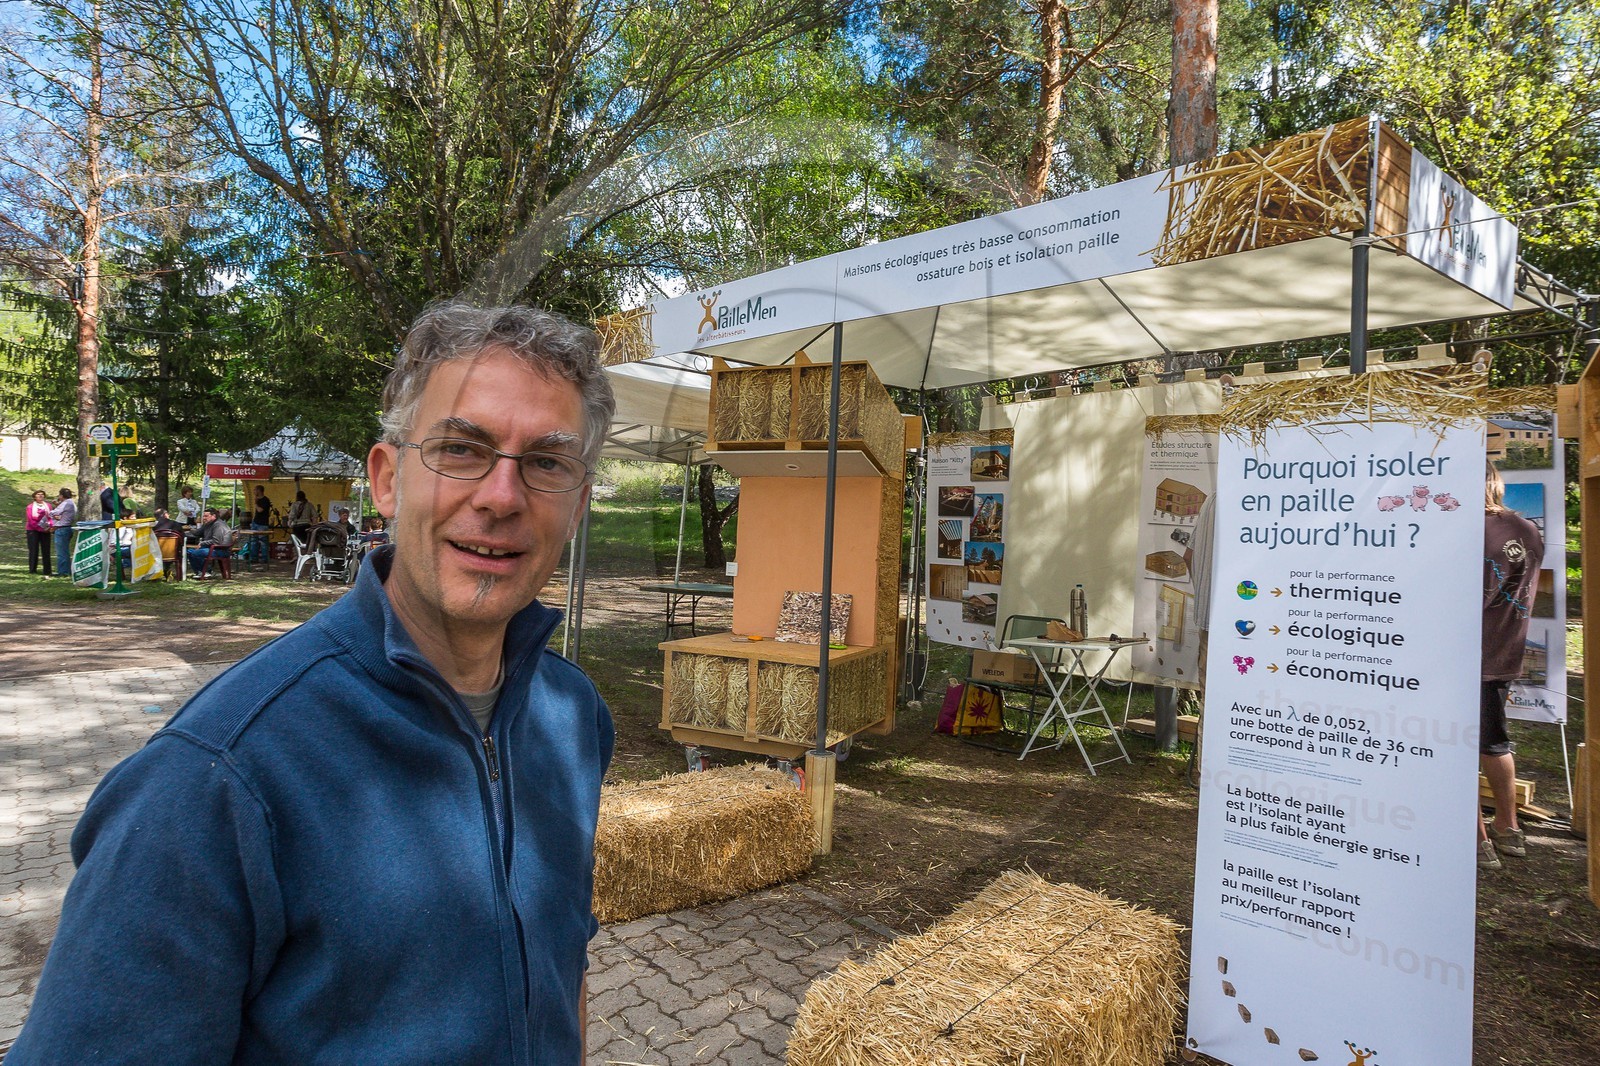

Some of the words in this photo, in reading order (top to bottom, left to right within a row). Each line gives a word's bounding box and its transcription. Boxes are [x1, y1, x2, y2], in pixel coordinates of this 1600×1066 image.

[843, 262, 882, 279] Maisons
[884, 246, 949, 269] écologiques
[952, 240, 976, 257] très
[979, 233, 1014, 250] basse
[1018, 209, 1121, 242] consommation
[916, 265, 965, 282] ossature
[969, 258, 994, 273] bois
[997, 254, 1012, 268] et
[1015, 242, 1073, 263] isolation
[1079, 232, 1120, 254] paille
[718, 296, 777, 330] PailleMen
[1160, 451, 1199, 459] thermique
[1177, 441, 1213, 449] structure
[223, 466, 257, 476] Buvette
[1243, 454, 1356, 484] Pourquoi
[1368, 451, 1451, 478] isoler
[1241, 494, 1271, 512] en
[1281, 488, 1355, 517] paille
[1408, 523, 1420, 548] ?
[1290, 570, 1312, 579] pour
[1315, 570, 1324, 579] la
[1327, 571, 1395, 582] performance
[1290, 583, 1402, 606] thermique
[1288, 609, 1311, 617] pour
[1313, 609, 1323, 618] la
[1326, 611, 1394, 623] performance
[1288, 621, 1405, 648] écologique
[1286, 648, 1309, 657] pour
[1312, 649, 1321, 658] la
[1324, 651, 1393, 665] performance
[982, 668, 1005, 677] WELEDA
[1286, 660, 1420, 691] économique
[1231, 702, 1262, 715] Avec
[1265, 707, 1282, 719] un
[1303, 713, 1320, 725] de
[1324, 715, 1371, 734] 0,052,
[1229, 728, 1303, 751] correspond
[1307, 741, 1315, 753] à
[1319, 744, 1337, 757] un
[1342, 747, 1351, 759] R
[1356, 750, 1374, 763] de
[1379, 753, 1388, 765] 7
[1394, 755, 1398, 767] !
[1230, 716, 1254, 728] une
[1258, 719, 1293, 734] botte
[1298, 726, 1315, 738] de
[1319, 730, 1358, 745] paille
[1363, 736, 1381, 749] de
[1387, 739, 1405, 753] 36
[1410, 746, 1434, 758] cm
[1227, 784, 1242, 797] La
[1245, 788, 1281, 804] botte
[1284, 796, 1301, 809] de
[1305, 802, 1345, 818] paille
[1226, 800, 1245, 811] est
[1306, 817, 1346, 834] ayant
[1225, 811, 1237, 823] la
[1240, 815, 1267, 830] plus
[1271, 822, 1309, 840] faible
[1313, 832, 1368, 854] énergie
[1372, 846, 1410, 864] grise
[1416, 855, 1420, 866] !
[1223, 859, 1234, 872] la
[1238, 865, 1274, 882] paille
[1277, 876, 1298, 889] est
[1222, 877, 1237, 889] au
[1241, 882, 1298, 905] meilleur
[1301, 899, 1355, 922] rapport
[1221, 893, 1341, 936] prix/performance
[1347, 927, 1351, 939] !
